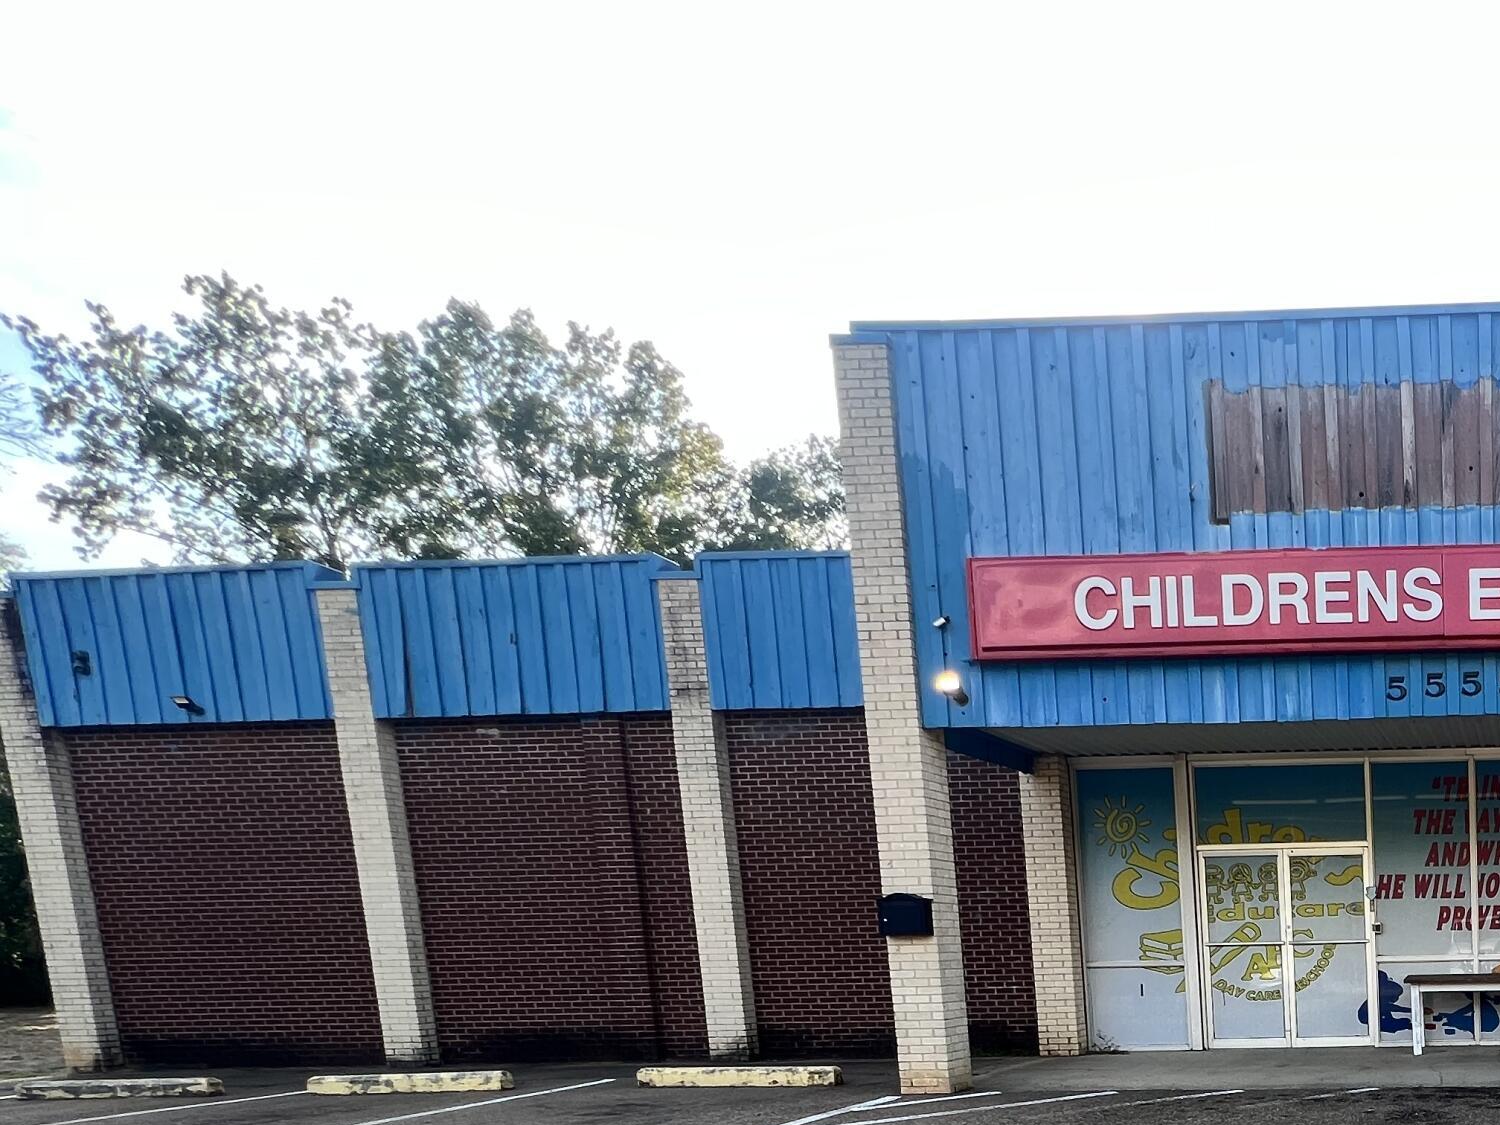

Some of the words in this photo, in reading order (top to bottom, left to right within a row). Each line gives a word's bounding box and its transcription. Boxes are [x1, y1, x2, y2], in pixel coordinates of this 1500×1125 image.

[1073, 566, 1444, 630] CHILDRENS
[1413, 808, 1456, 835] THE
[1375, 874, 1406, 900] HE
[1414, 874, 1466, 899] WILL
[1212, 978, 1246, 1000] DAY
[1245, 989, 1282, 1001] CARE
